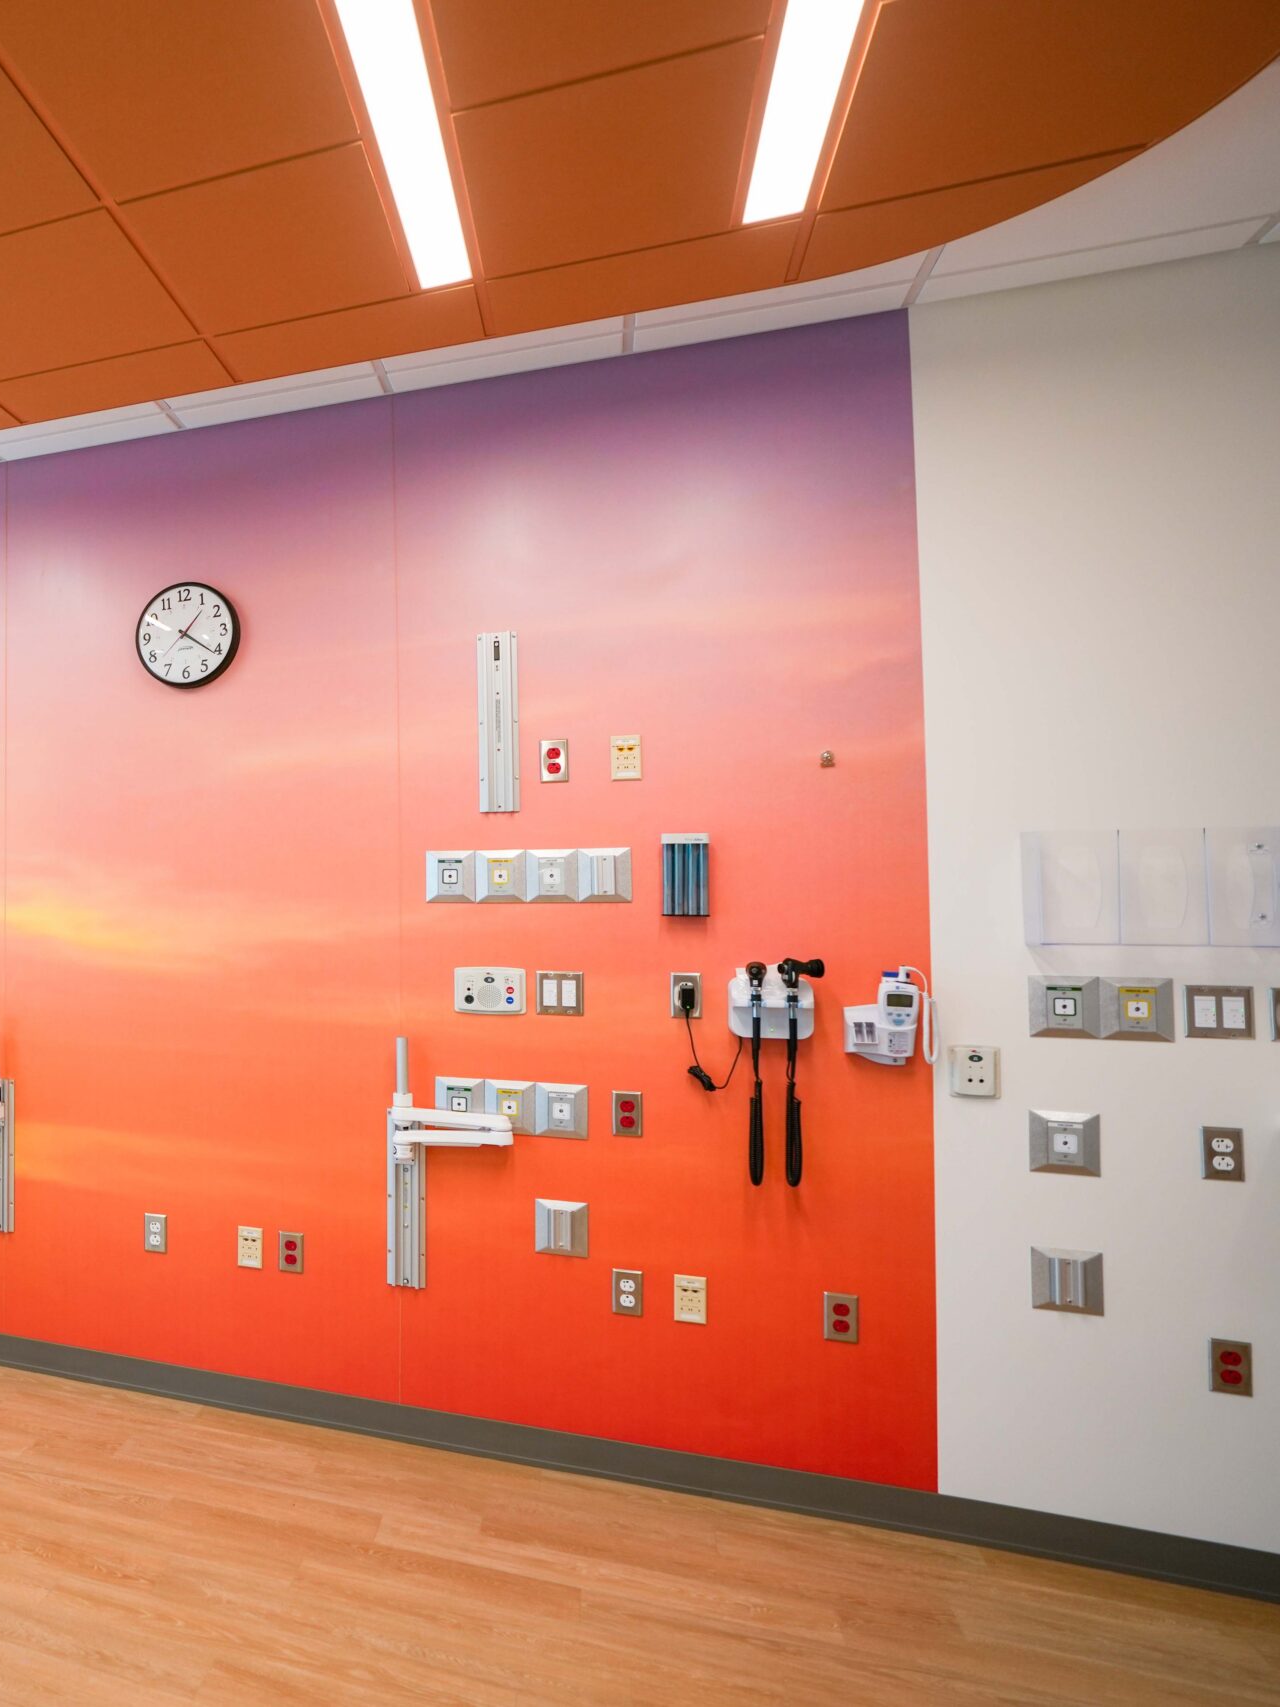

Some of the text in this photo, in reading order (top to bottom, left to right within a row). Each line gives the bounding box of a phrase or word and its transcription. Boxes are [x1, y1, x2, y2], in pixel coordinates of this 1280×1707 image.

[177, 588, 192, 602] 12
[199, 593, 205, 605] 1
[161, 598, 172, 610] 11
[213, 605, 221, 618] 2
[220, 623, 228, 636] 3
[143, 633, 151, 646] 9
[214, 643, 223, 655] 4
[148, 650, 157, 663] 8
[164, 664, 172, 677] 7
[200, 659, 208, 673] 5
[182, 666, 190, 680] 6
